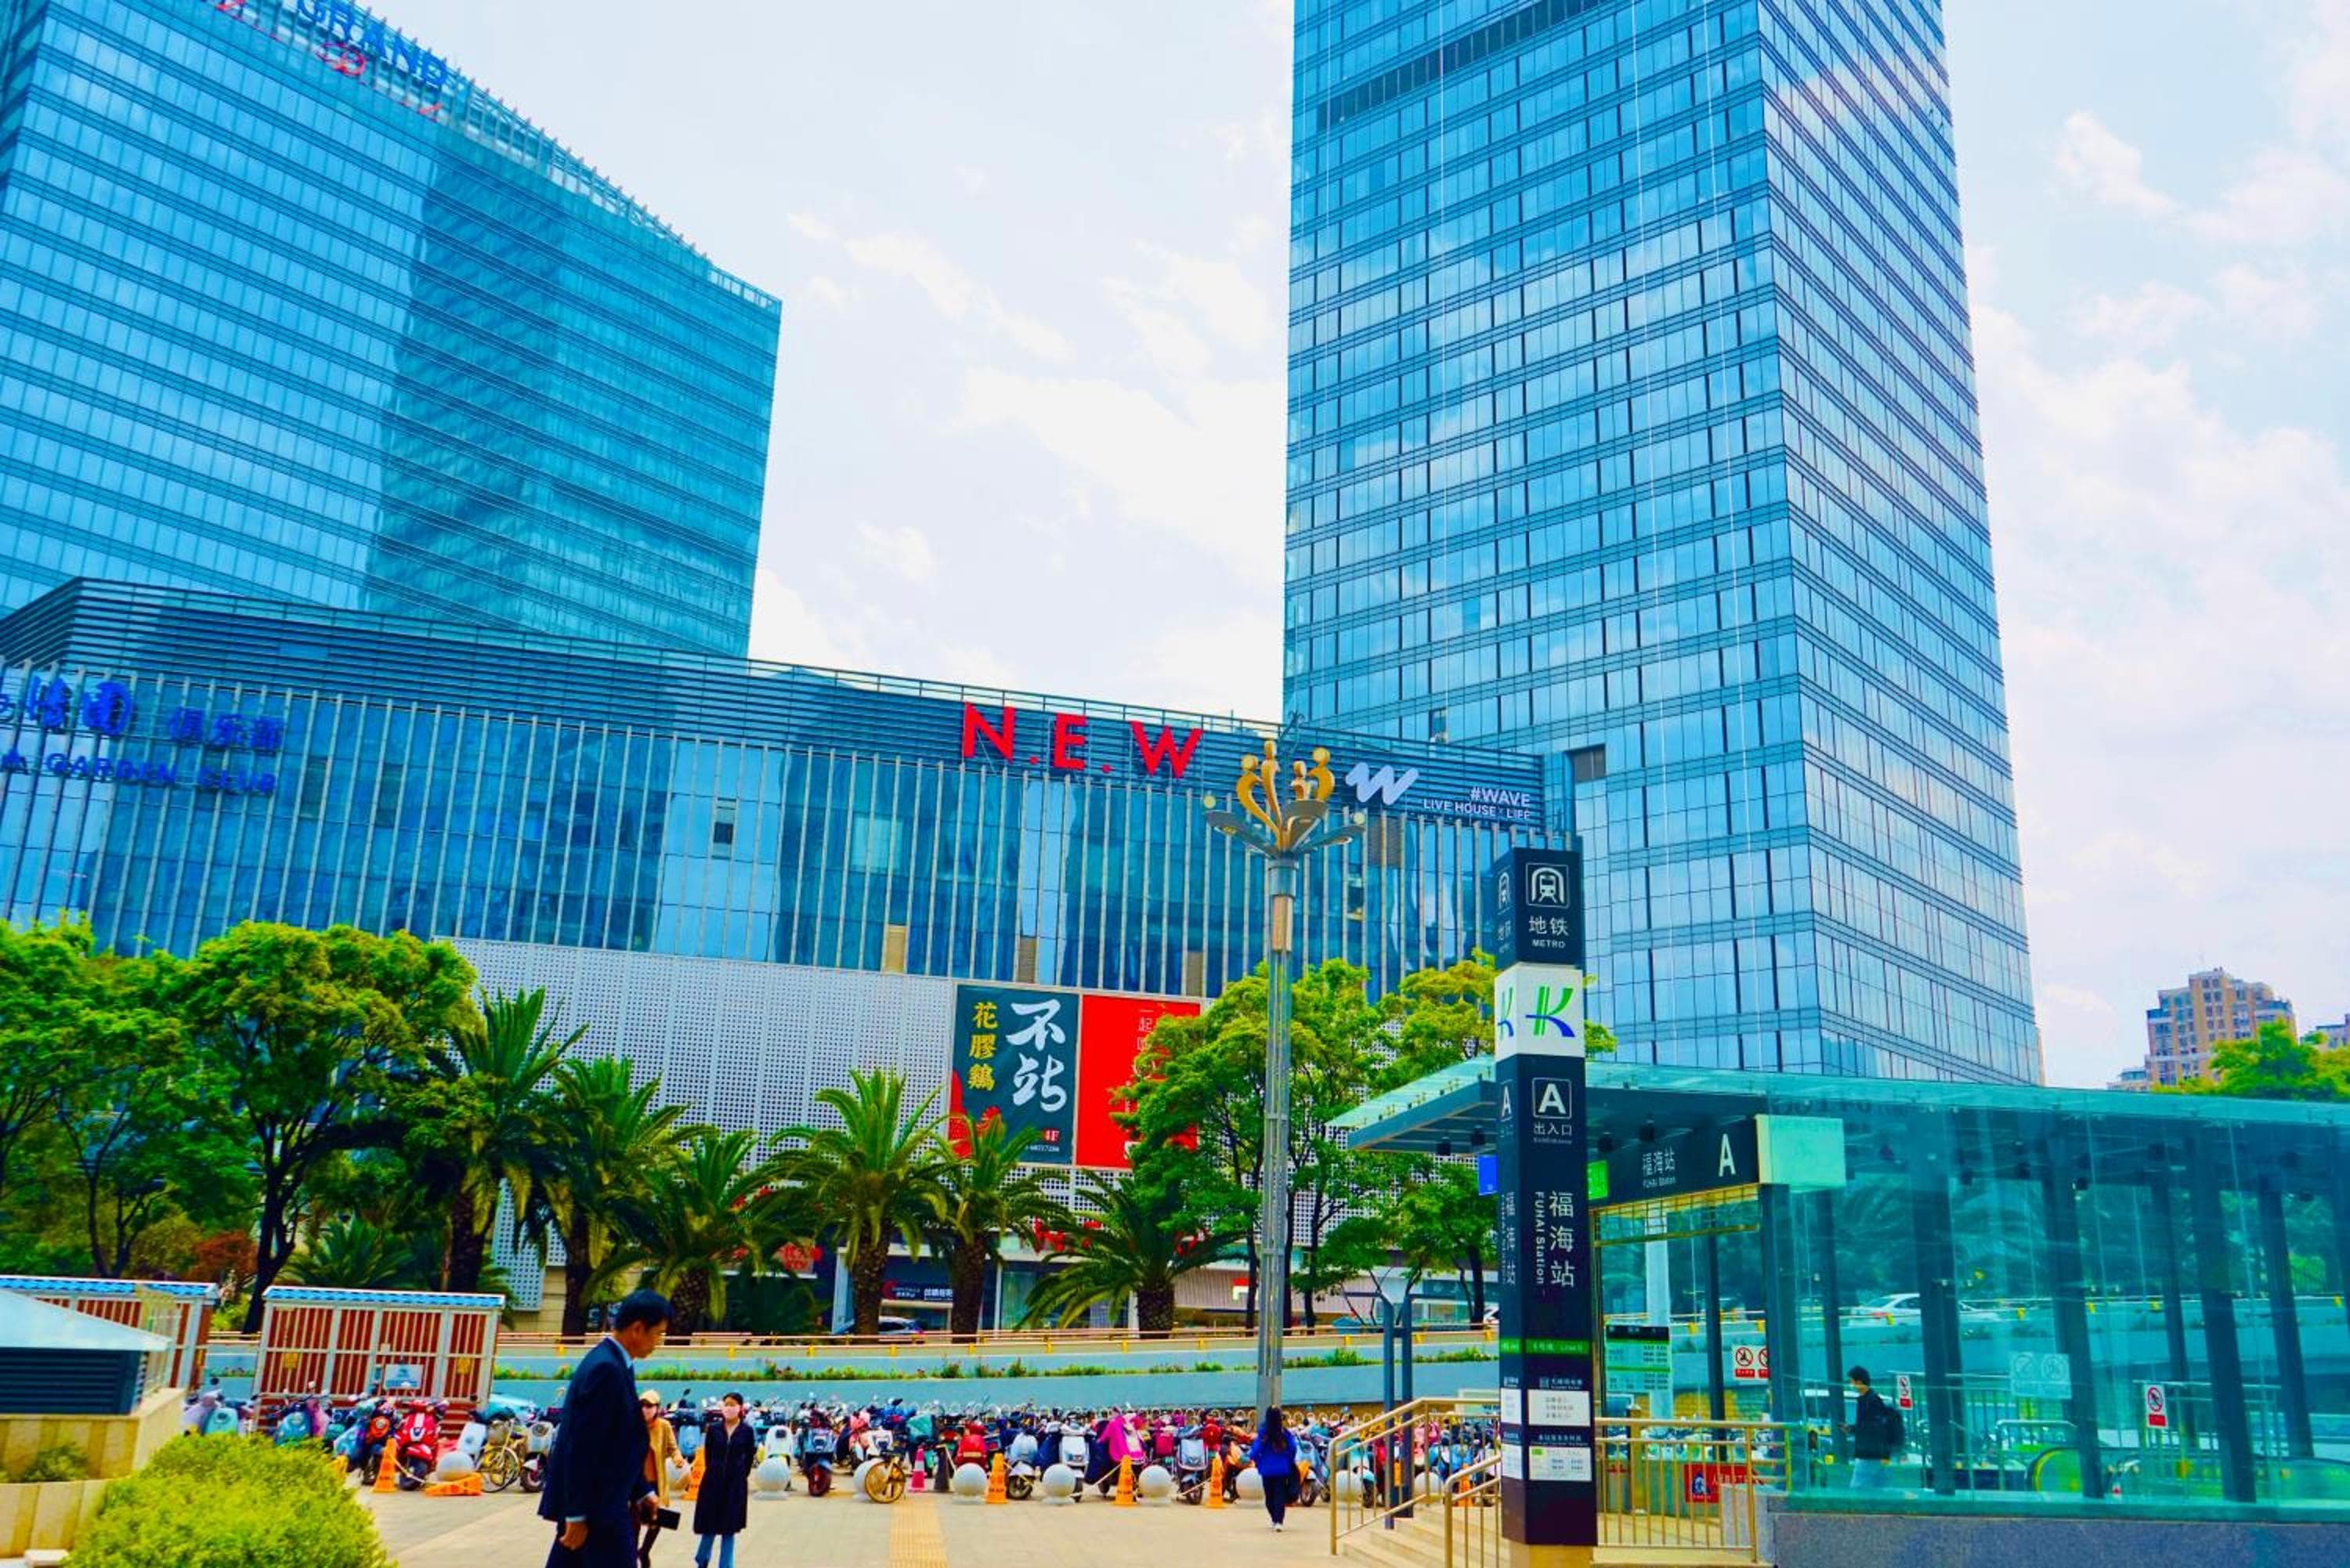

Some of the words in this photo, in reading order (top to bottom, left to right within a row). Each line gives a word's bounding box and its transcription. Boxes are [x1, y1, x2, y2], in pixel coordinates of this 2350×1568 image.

[296, 0, 448, 85] GRAND
[1423, 798, 1452, 811] LIVE
[1454, 800, 1496, 818] HOUSE
[1470, 786, 1531, 808] #WAVE
[1528, 915, 1569, 937] 地铁
[1531, 939, 1566, 948] METRO
[1538, 1083, 1567, 1115] A
[1533, 1122, 1573, 1136] 出入口
[1642, 1146, 1676, 1177] 福海站
[1719, 1133, 1737, 1177] A
[1535, 1190, 1546, 1233] FUHAI
[1549, 1190, 1576, 1288] 福海站
[1535, 1236, 1546, 1284] Station
